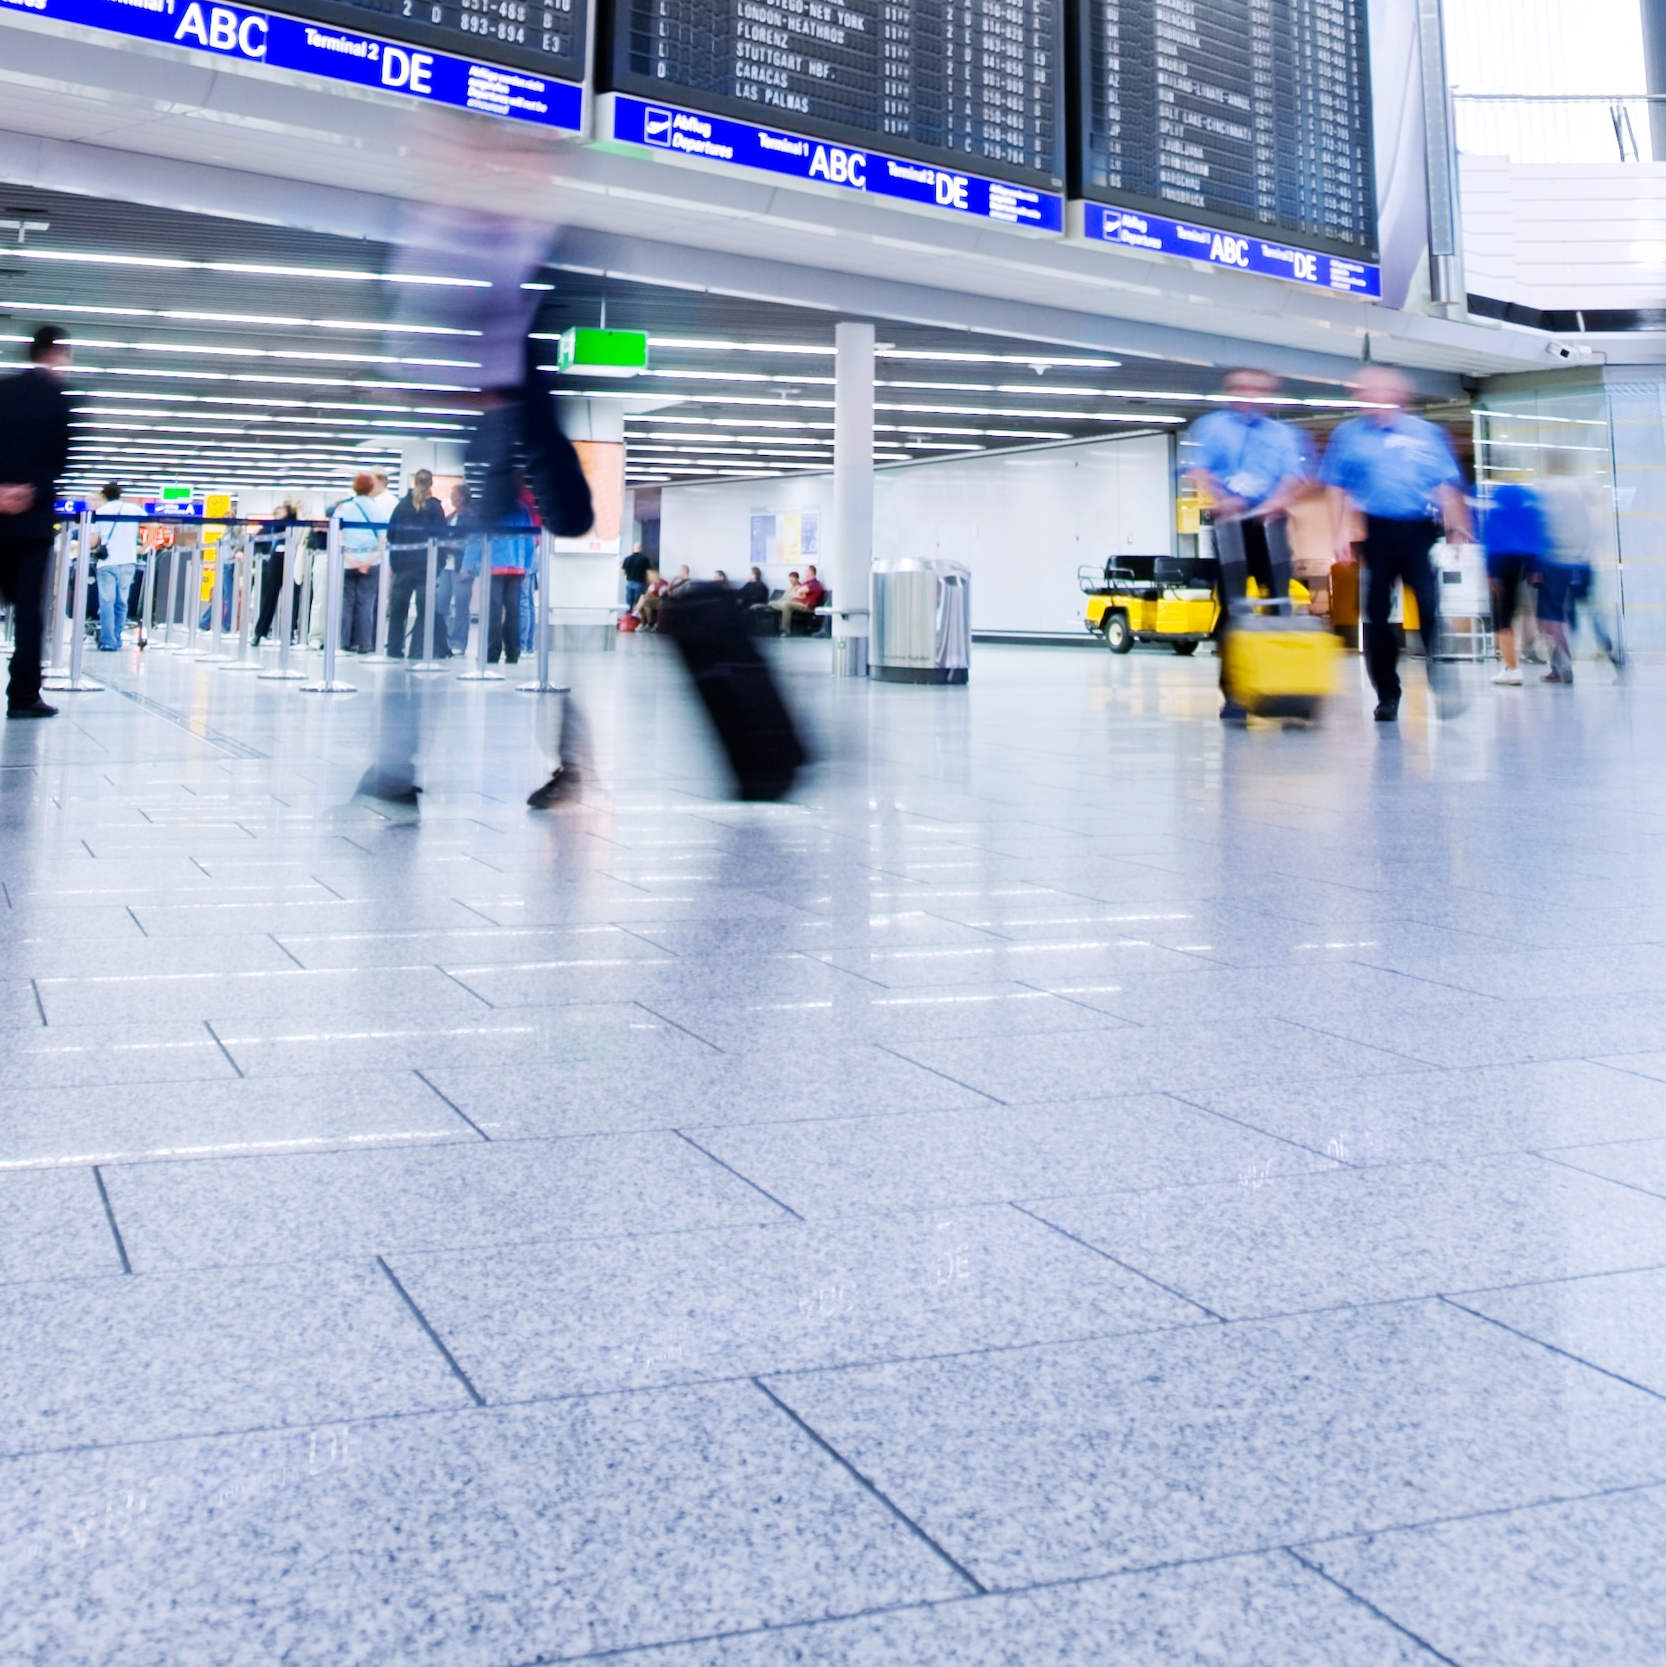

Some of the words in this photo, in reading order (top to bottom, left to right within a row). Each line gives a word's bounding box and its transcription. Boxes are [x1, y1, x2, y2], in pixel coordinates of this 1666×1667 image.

[173, 2, 268, 58] ABC
[737, 21, 788, 48] FLORENZ
[305, 28, 367, 58] Terminal
[367, 44, 379, 61] 2
[381, 46, 433, 94] DE
[737, 42, 802, 71] STUTTGART
[736, 61, 787, 88] CARACAS
[736, 82, 758, 100] LAS
[672, 113, 711, 138] Abflug
[671, 132, 733, 160] Departures
[758, 132, 803, 156] Terminal
[803, 142, 809, 157] 1
[809, 145, 867, 188] ABC
[887, 162, 925, 184] Terminal
[925, 170, 935, 186] 2
[935, 173, 969, 209] DE
[1209, 234, 1249, 267] ABC
[1293, 252, 1317, 282] DE
[65, 501, 73, 512] C
[186, 504, 195, 515] A
